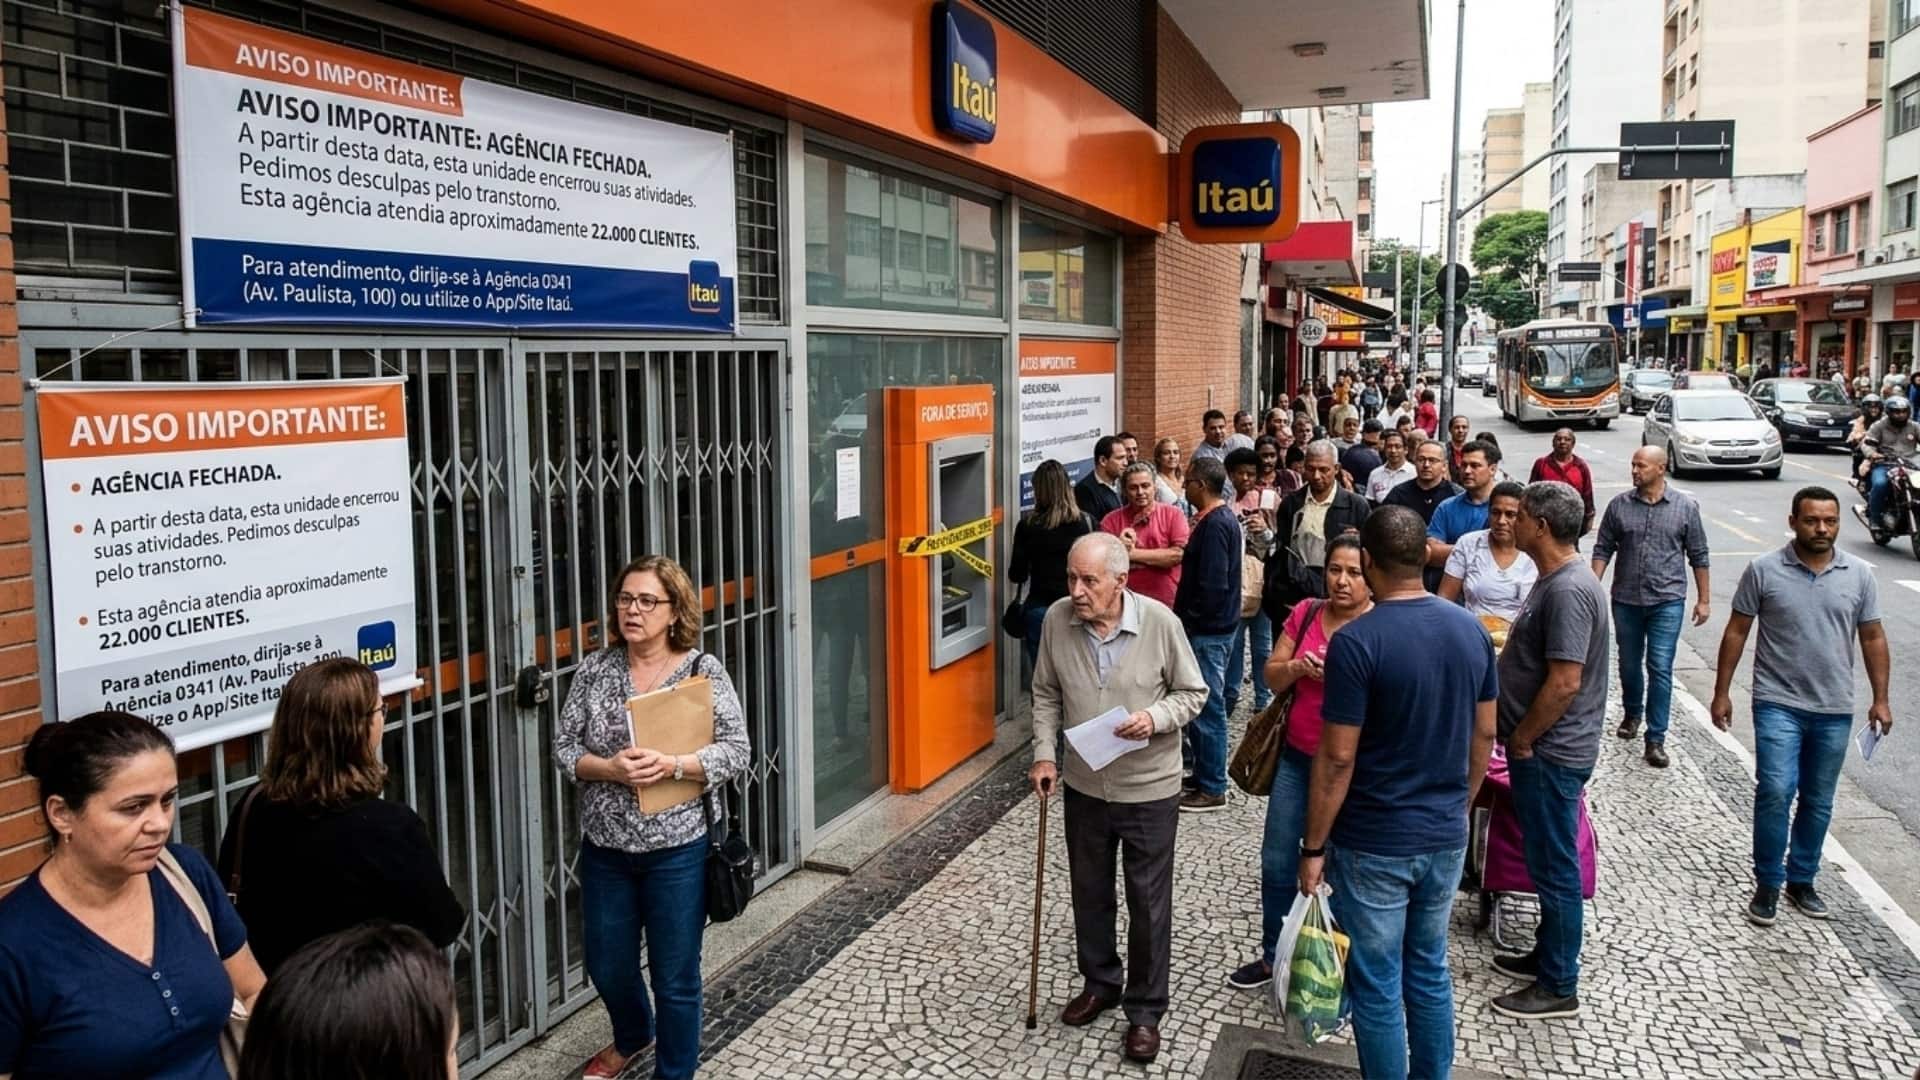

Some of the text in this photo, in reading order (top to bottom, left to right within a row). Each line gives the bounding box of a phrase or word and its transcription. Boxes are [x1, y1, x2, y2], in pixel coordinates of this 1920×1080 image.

[235, 43, 456, 108] AVISO IMPORTANTE:
[952, 61, 996, 124] Itaú
[237, 88, 652, 179] AVISO IMPORTANTE: AGÊNCIA FECHADA.
[238, 121, 697, 208] A partir desta data, esta unidade encerrou suas atividades.
[240, 152, 560, 212] Pedimos desculpas pelo transtorno.
[241, 183, 700, 250] Esta agência atendia aproximadamente 22.000 CLIENTES.
[1198, 178, 1274, 214] Itaú
[243, 254, 284, 276] Para
[289, 259, 405, 285] atendimento,
[409, 264, 469, 288] dirija-se
[472, 268, 481, 286] à
[484, 270, 540, 291] Agência
[691, 283, 719, 303] Itaú
[243, 280, 574, 313] (Av. Paulista, 100) ou utilize o App/Site Itaú.
[69, 404, 386, 447] AVISO IMPORTANTE:
[921, 404, 944, 423] FORA
[91, 463, 282, 497] AGÊNCIA FECHADA.
[93, 490, 400, 538] A partir desta data, esta unidade encerrou
[94, 514, 360, 560] suas atividades. Pedimos desculpas
[95, 553, 227, 588] pelo transtorno.
[97, 565, 388, 627] Esta agência atendia aproximadamente
[99, 609, 250, 651] 22.000 CLIENTES.
[101, 635, 323, 696] Para atendimento, dirija-se à
[360, 643, 395, 665] Itaú
[176, 679, 214, 701] 0341
[219, 674, 248, 693] (Av.
[177, 710, 188, 723] o
[192, 690, 259, 721] App/Site
[262, 684, 286, 702] Ita
